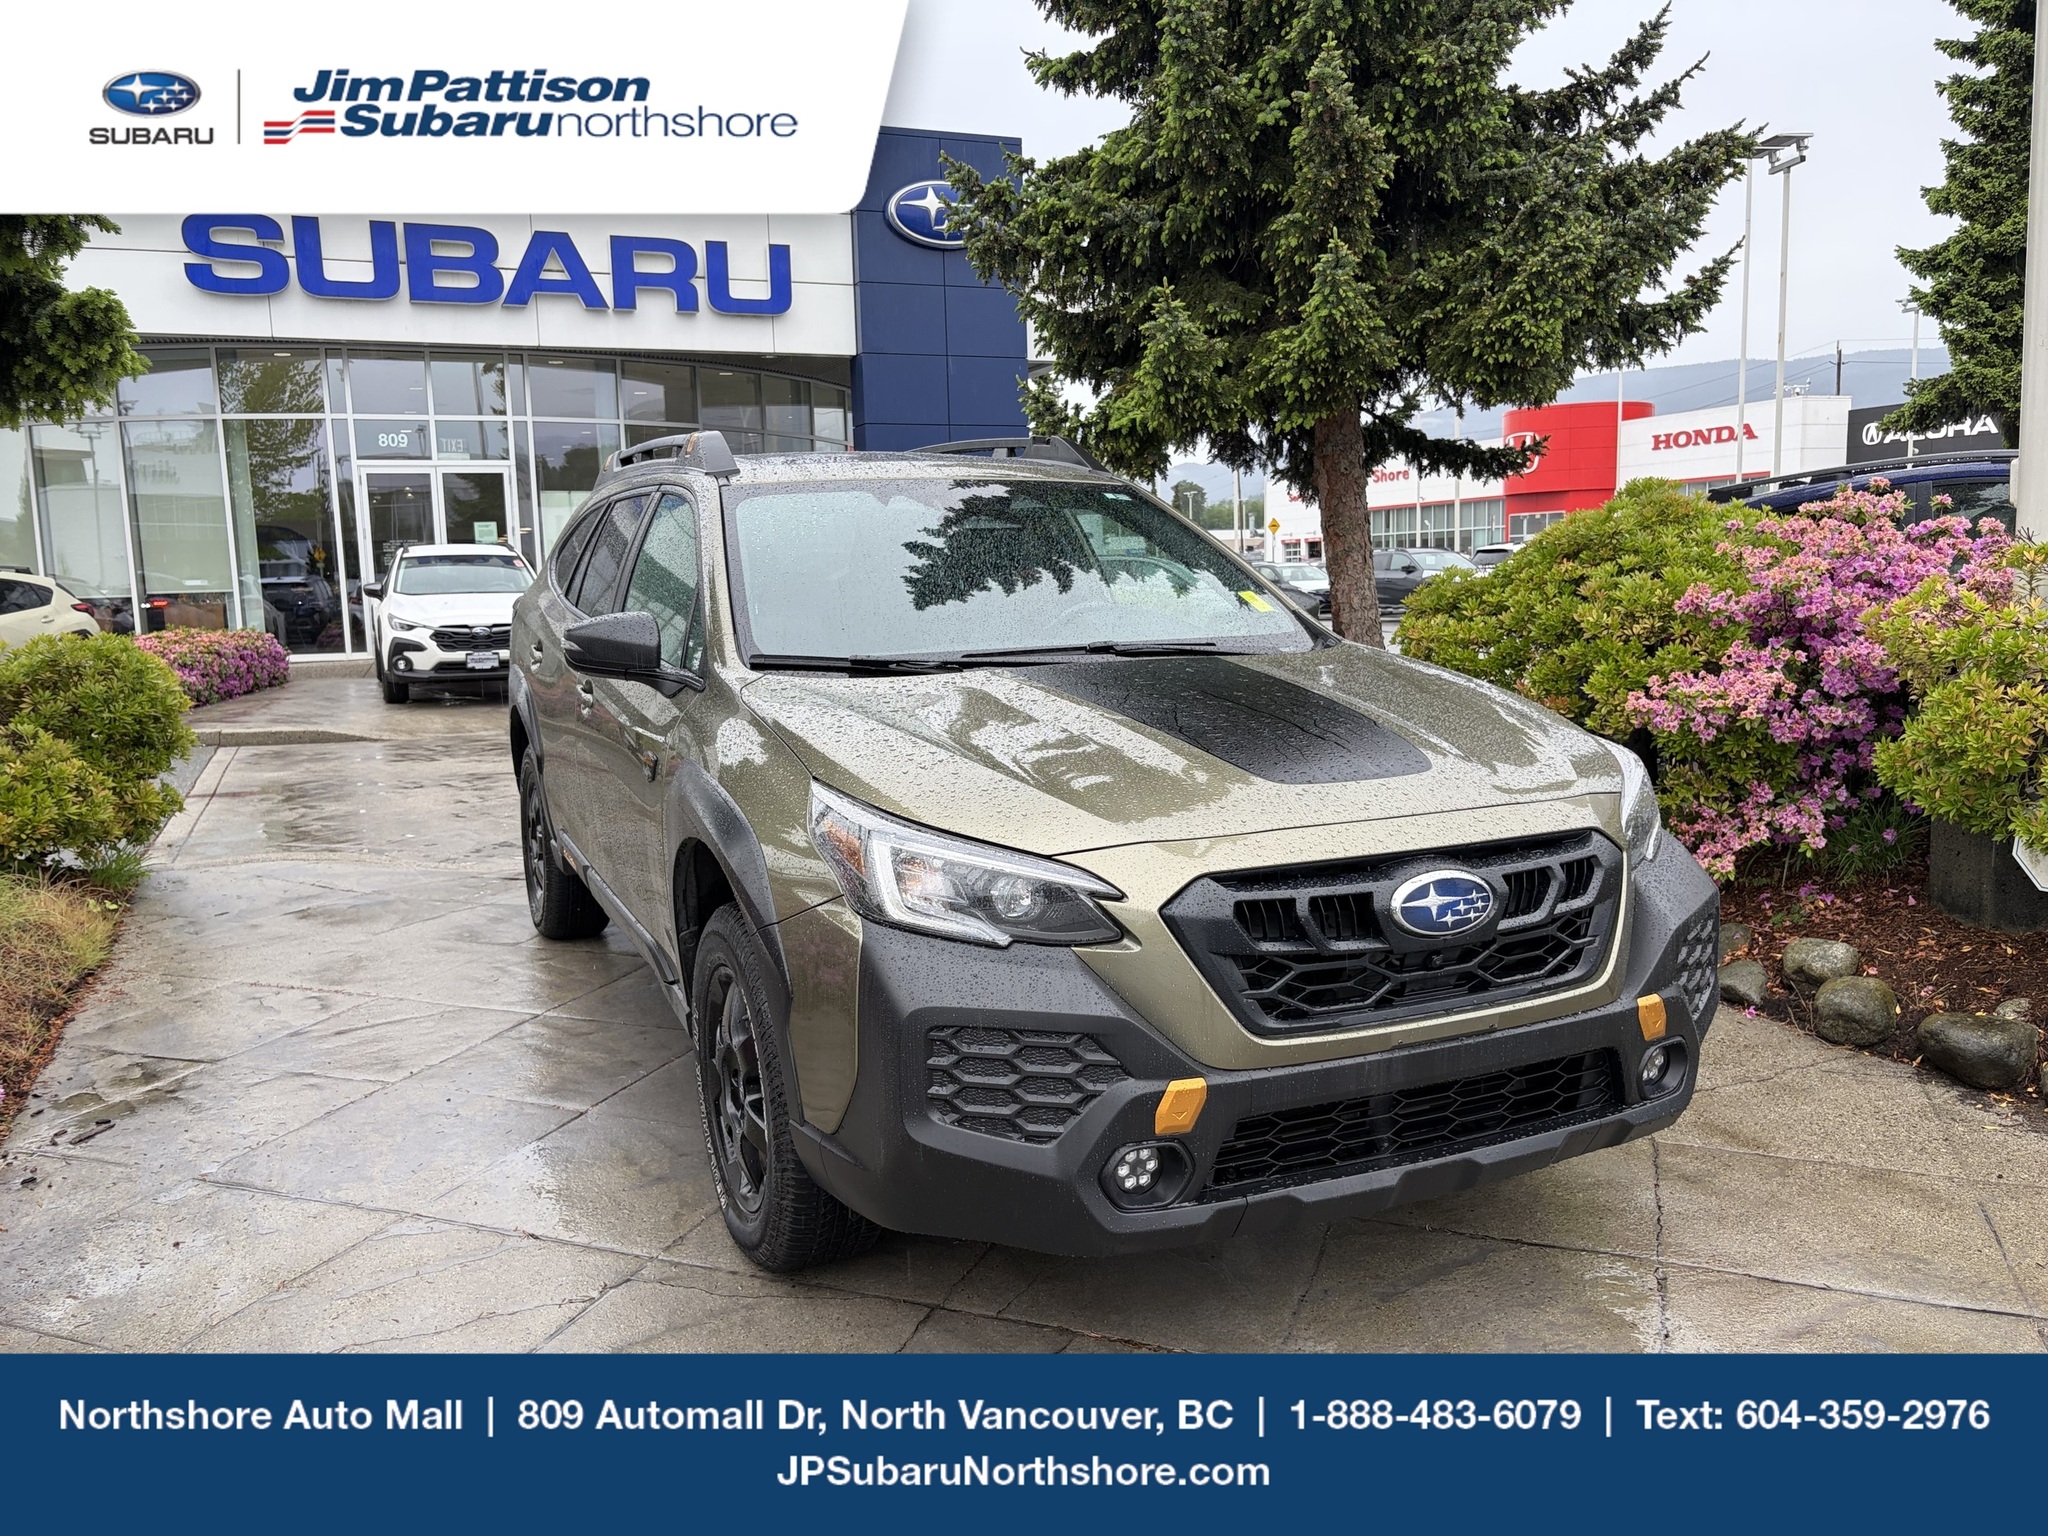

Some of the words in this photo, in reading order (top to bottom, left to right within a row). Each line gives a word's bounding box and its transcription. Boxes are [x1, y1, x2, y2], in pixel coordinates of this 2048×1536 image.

[181, 214, 793, 317] SUBARU
[378, 432, 408, 448] 809
[1651, 422, 1759, 451] HONDA
[1372, 469, 1410, 483] Shore
